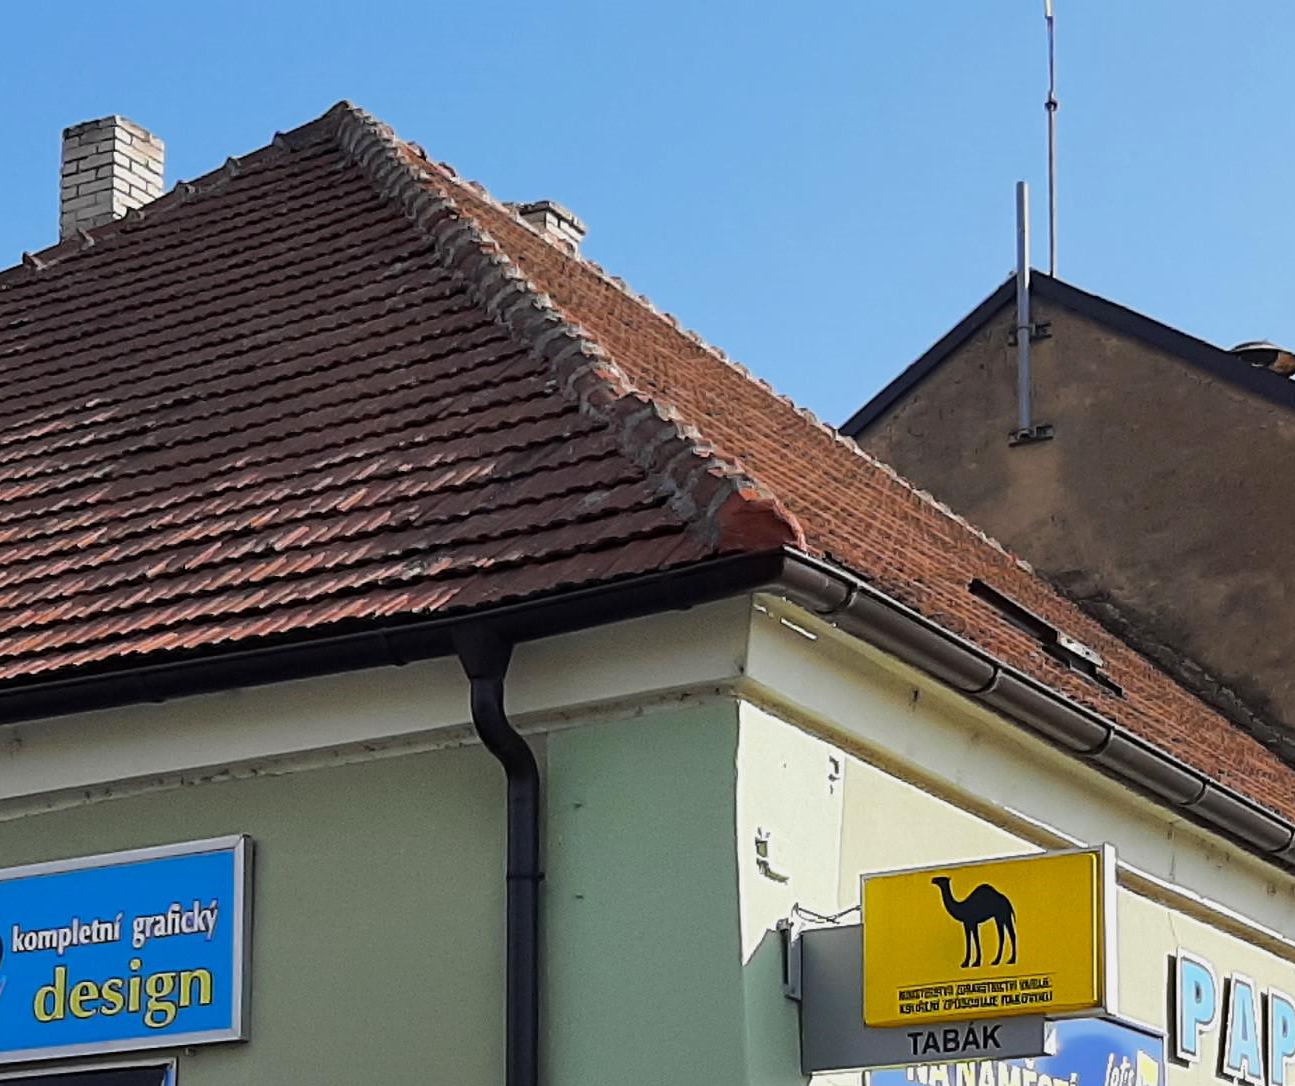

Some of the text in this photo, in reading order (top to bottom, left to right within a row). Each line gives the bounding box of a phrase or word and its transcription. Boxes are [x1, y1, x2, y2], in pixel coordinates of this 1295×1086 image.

[11, 899, 219, 954] kompletní grafický
[33, 958, 212, 1028] design
[907, 1022, 1002, 1056] TABÁK
